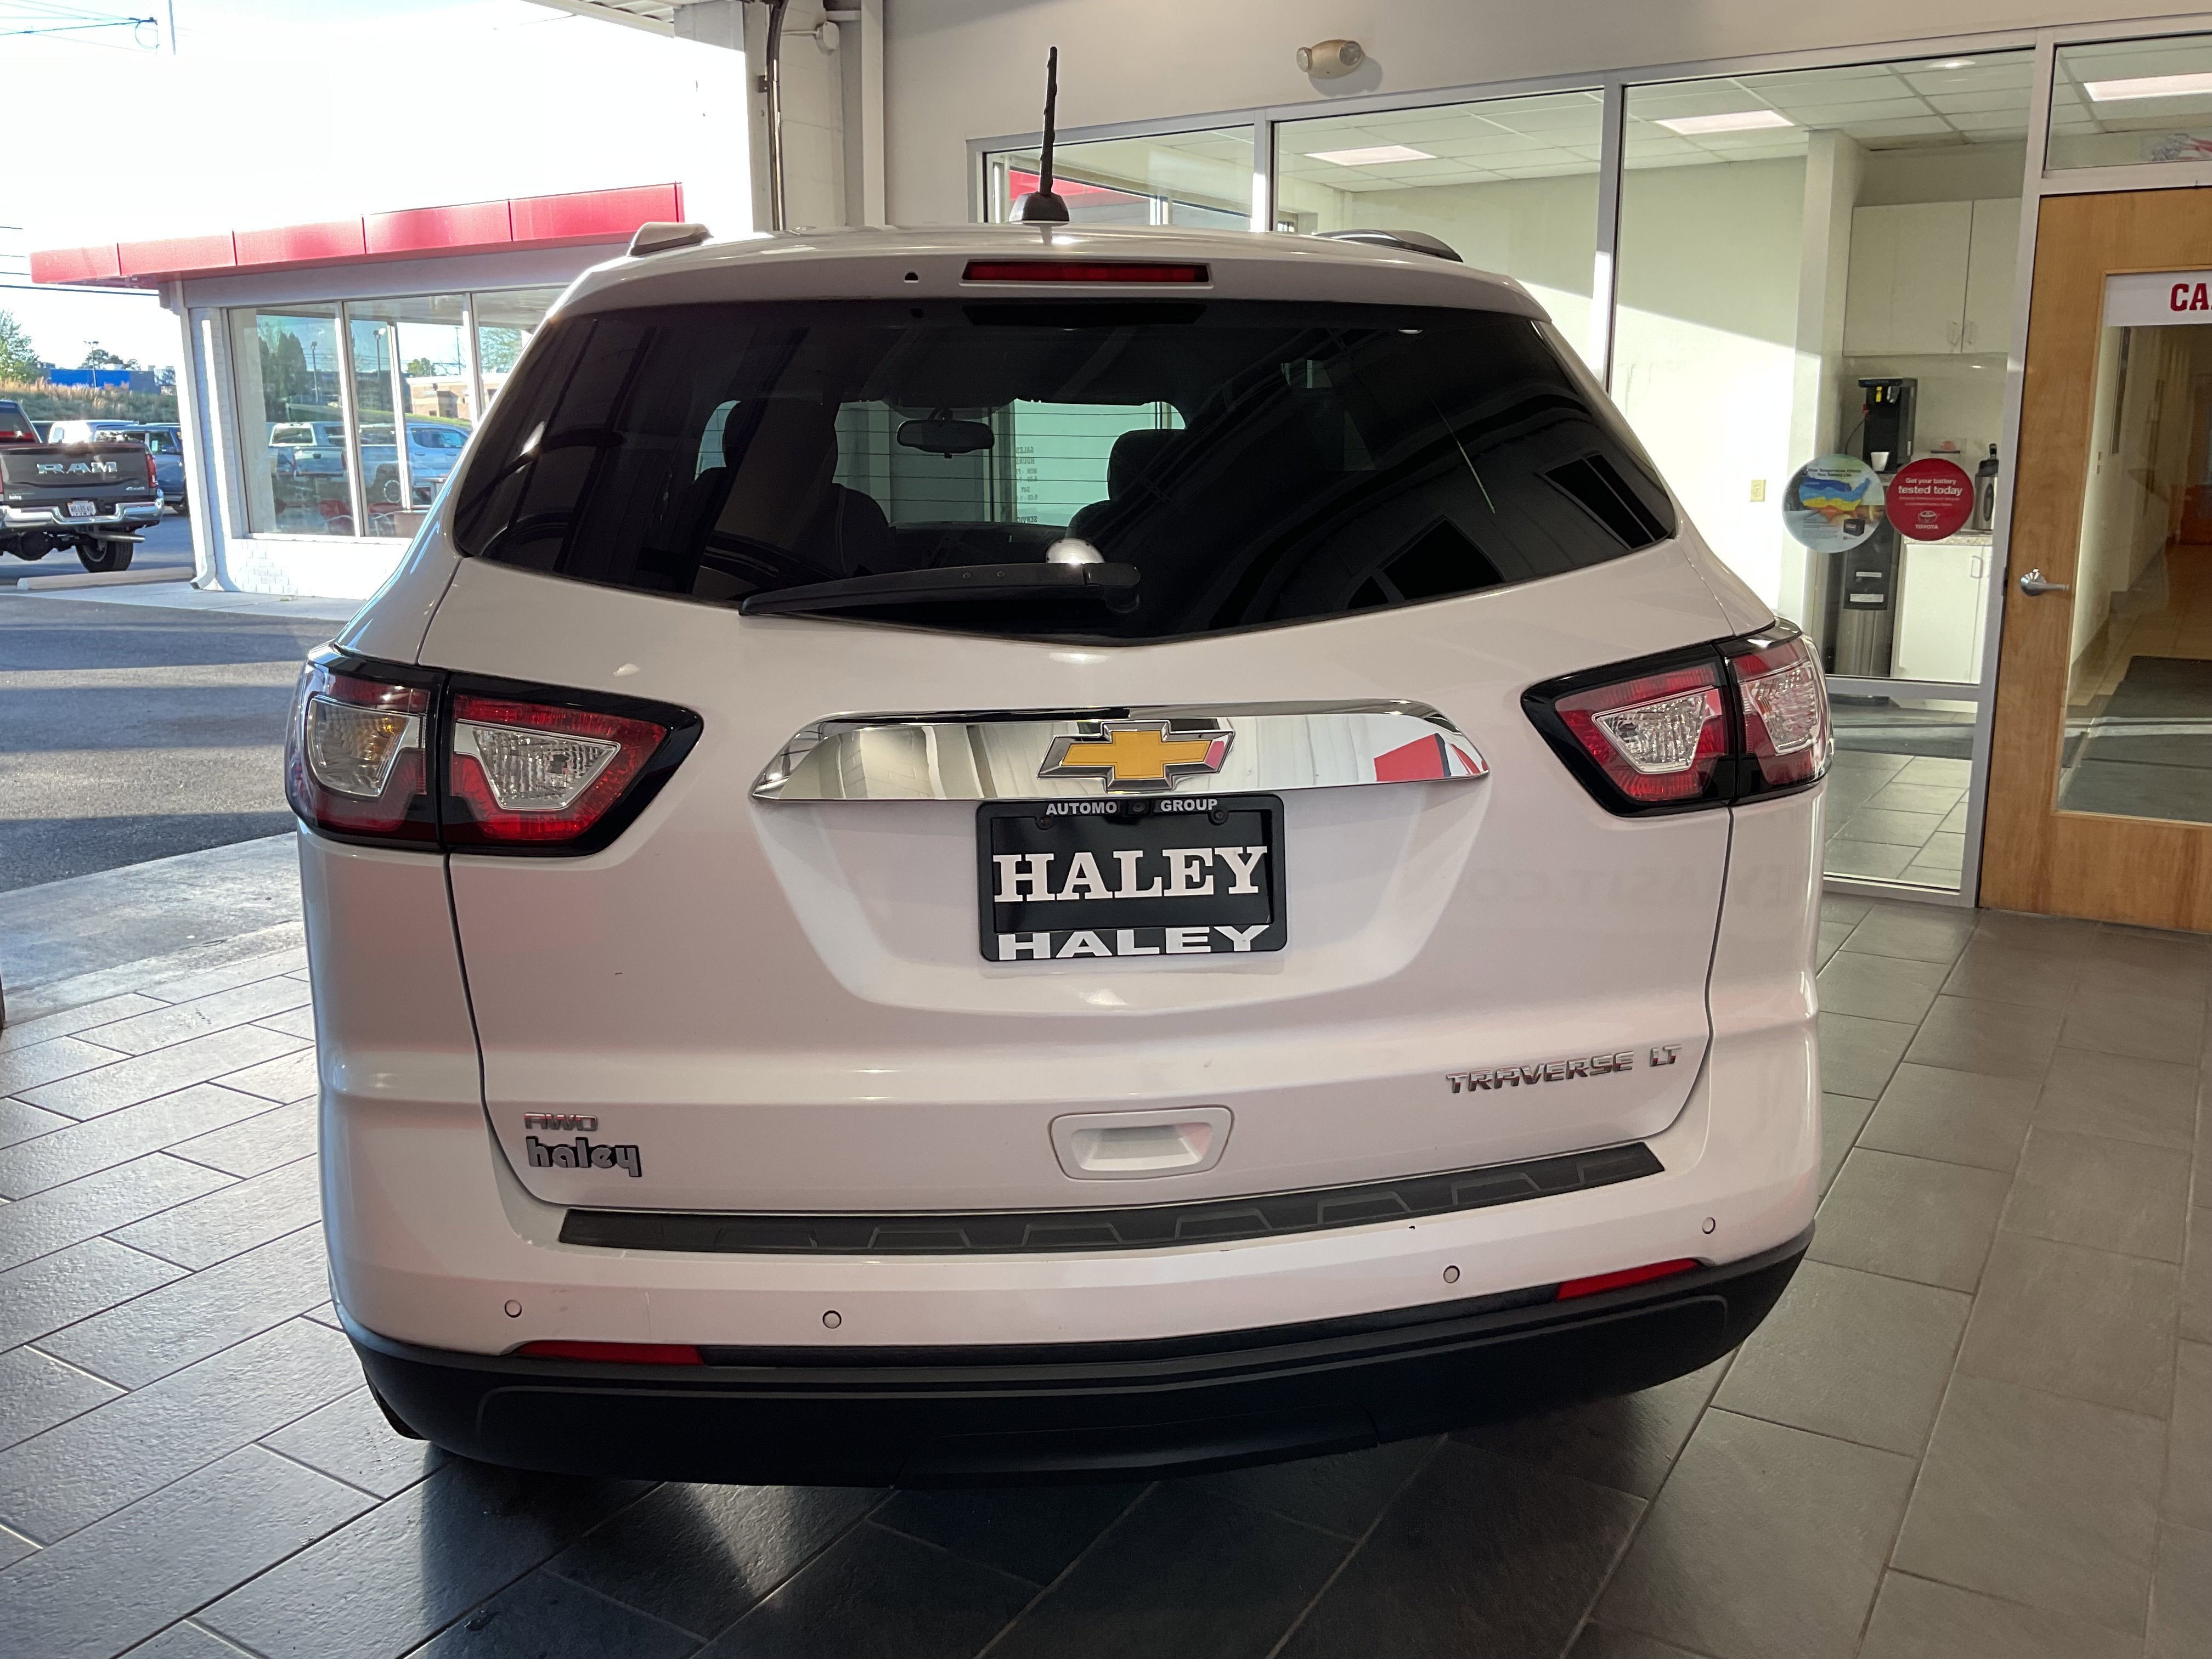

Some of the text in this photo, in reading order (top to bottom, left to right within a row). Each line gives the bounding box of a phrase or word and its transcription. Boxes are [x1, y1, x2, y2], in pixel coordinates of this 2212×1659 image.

[2170, 283, 2212, 311] CA
[37, 462, 117, 474] RAM
[1898, 486, 1963, 496] tested today
[1046, 799, 1217, 815] AUTOMO GROUP
[993, 846, 1267, 902] HALEY
[998, 925, 1269, 961] HALEY
[1446, 1043, 1682, 1094] TRAVERSE LT
[524, 1113, 598, 1131] AWD
[526, 1136, 642, 1177] haley
